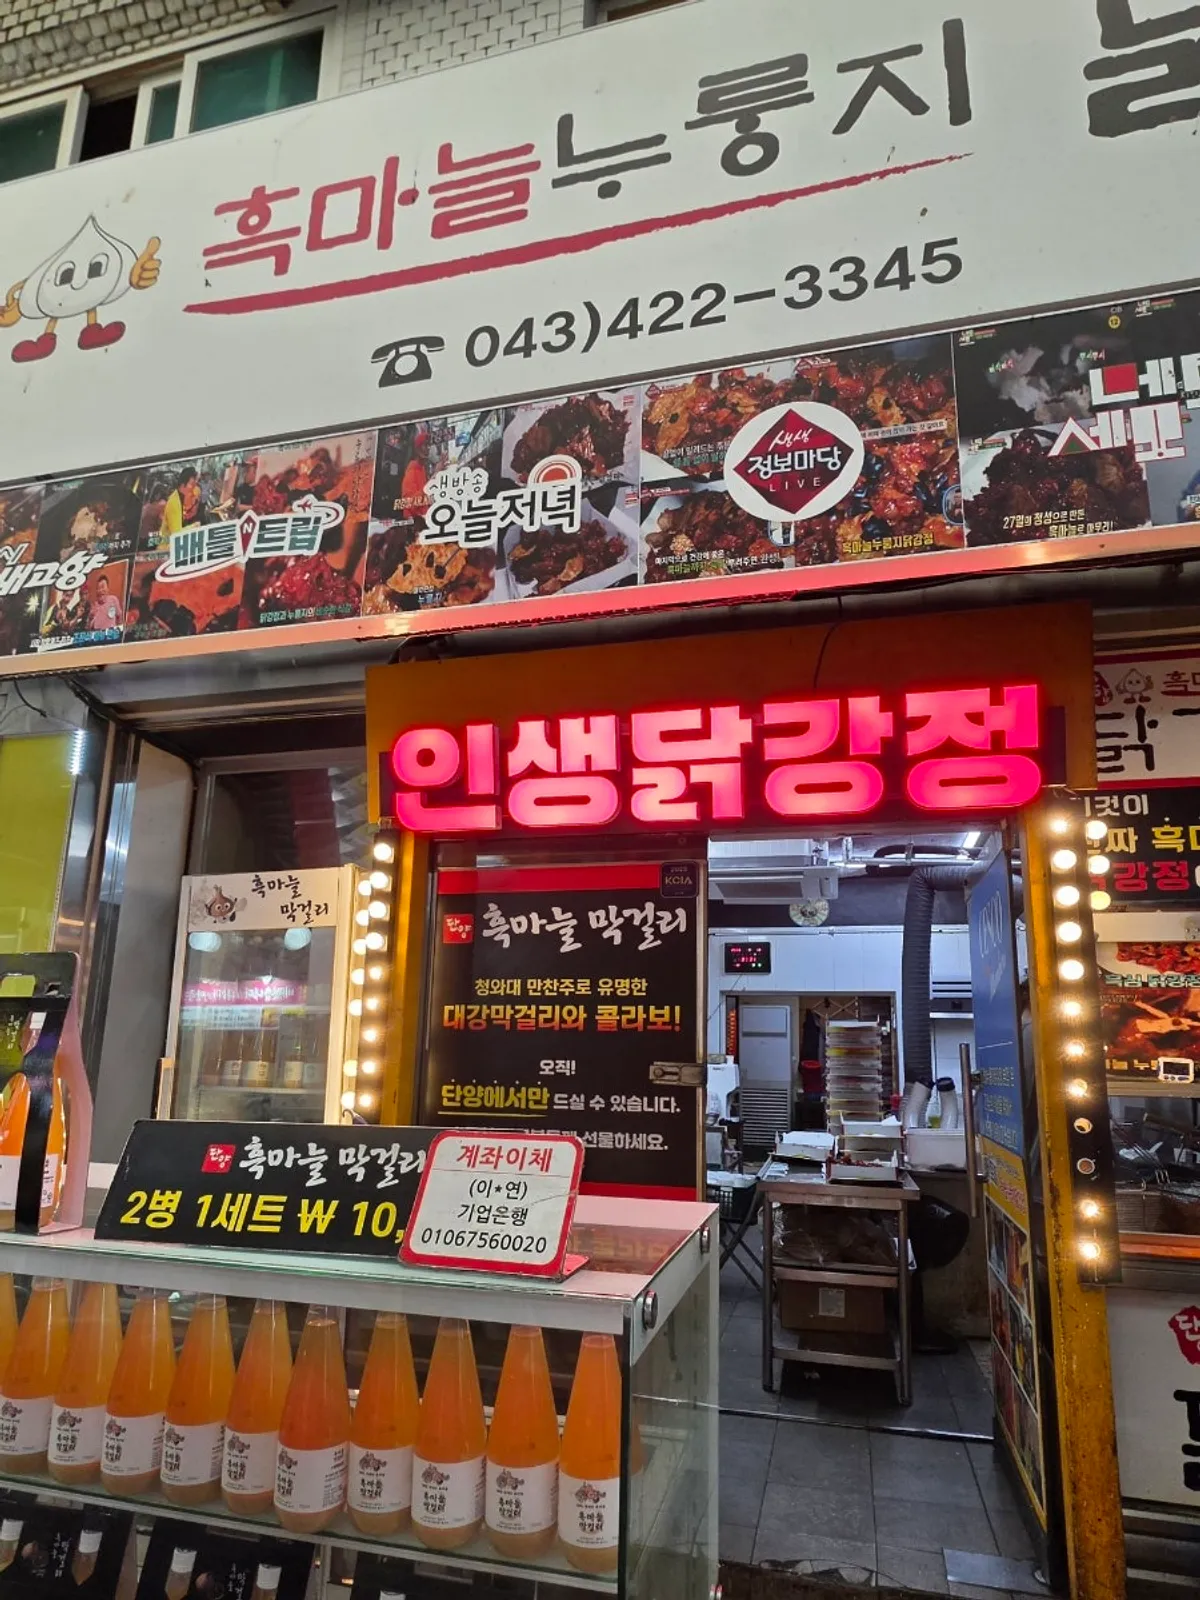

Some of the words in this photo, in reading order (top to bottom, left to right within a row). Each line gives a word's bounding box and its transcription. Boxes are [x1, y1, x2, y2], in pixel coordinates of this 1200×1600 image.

[465, 237, 963, 368] 043)422-3345
[769, 428, 813, 450] 생생
[748, 446, 842, 478] 정보마당
[430, 471, 483, 499] 생방송
[769, 477, 822, 492] LIVE
[425, 485, 577, 543] 오늘저녁
[1033, 509, 1069, 526] 정성으로
[1086, 519, 1114, 533] 마무리!
[392, 684, 1043, 832] 인생닭강정
[252, 874, 303, 899] 흑마늘
[665, 875, 693, 885] KCIA
[281, 900, 330, 925] 막걸리
[482, 902, 583, 954] 흑마늘
[588, 901, 688, 951] 막걸리
[474, 977, 522, 997] 청와대
[526, 978, 592, 997] 만찬주로
[597, 977, 649, 997] 유명한
[443, 1004, 587, 1032] 대강막걸리와
[594, 1004, 682, 1032] 콜라보!
[539, 1059, 577, 1076] 오직!
[440, 1083, 549, 1111] 단양에서만
[552, 1094, 586, 1111] 드실
[589, 1094, 606, 1111] 수
[610, 1095, 682, 1114] 있습니다.
[582, 1132, 669, 1151] 선물하세요.
[239, 1136, 328, 1187] 흑마늘
[338, 1143, 427, 1189] 막걸리
[456, 1144, 554, 1173] 계좌이체
[120, 1189, 182, 1229] 2병
[196, 1193, 288, 1233] 1세트
[457, 1203, 529, 1227] 기업은행
[421, 1227, 548, 1254] 01067560020
